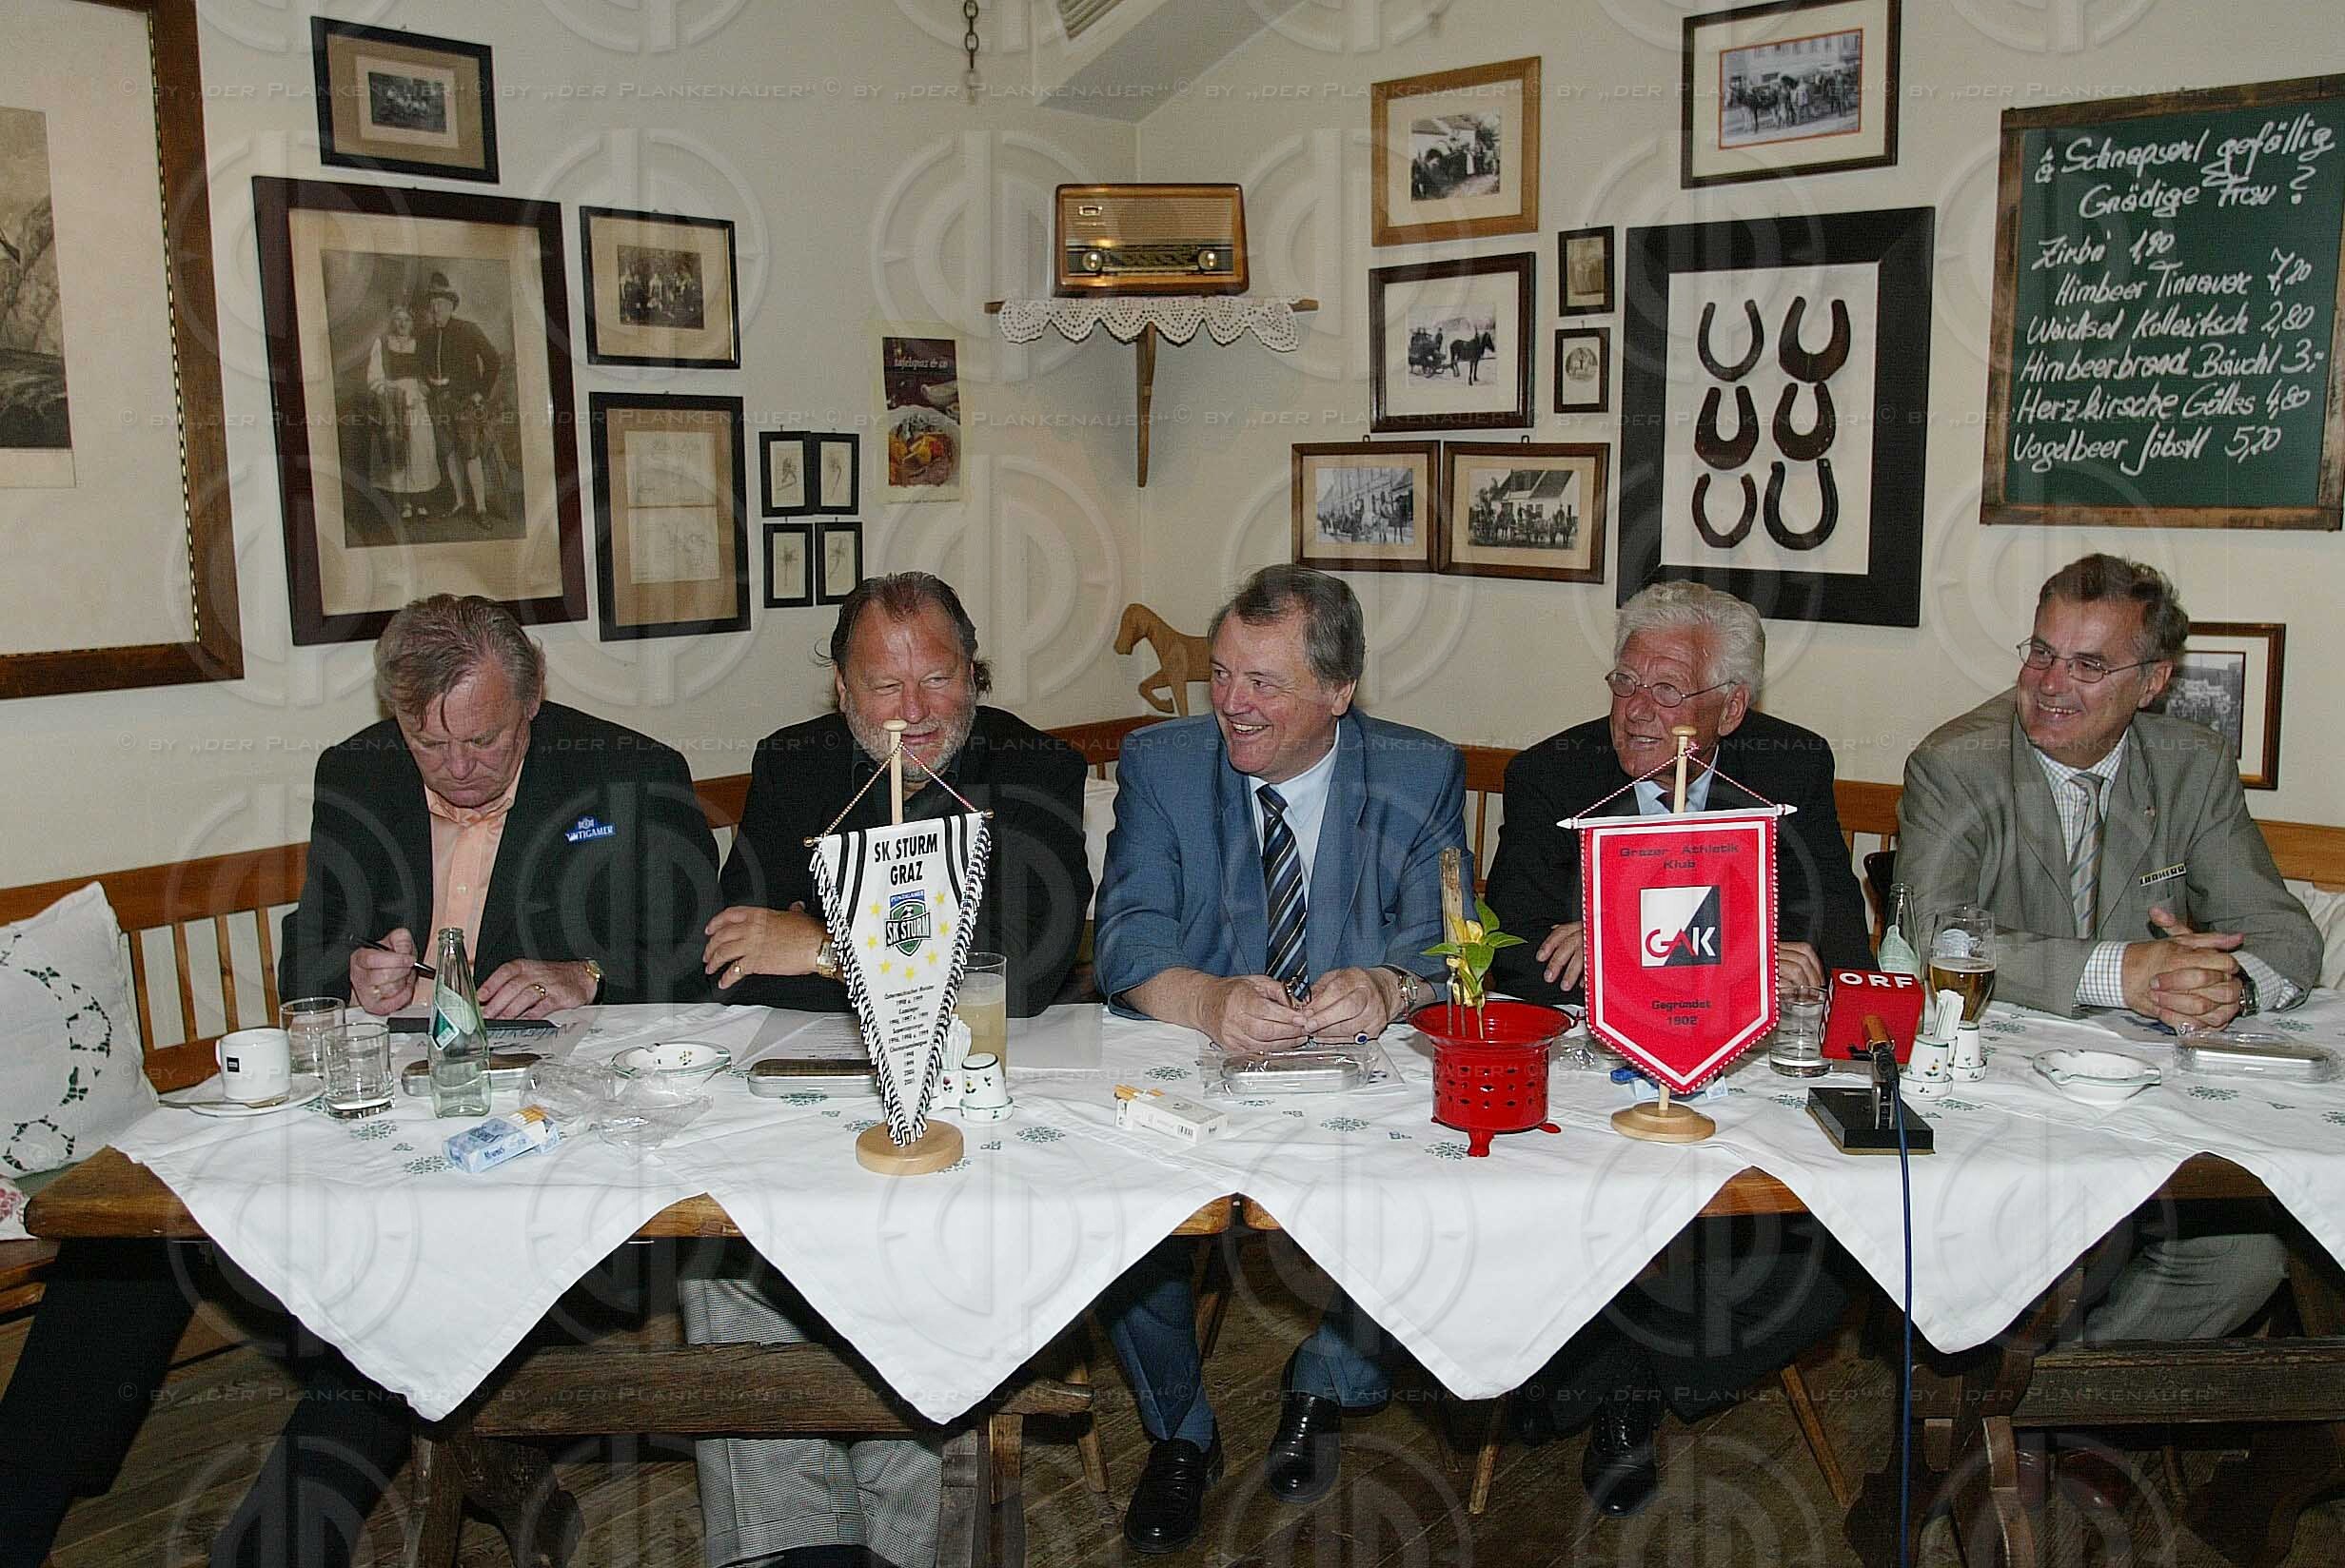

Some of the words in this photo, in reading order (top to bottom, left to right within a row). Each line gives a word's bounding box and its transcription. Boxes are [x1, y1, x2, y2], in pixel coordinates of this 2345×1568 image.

[2079, 178, 2199, 218] Gnädige
[2201, 175, 2276, 206] Frau
[2289, 165, 2317, 205] ?
[2055, 270, 2148, 306] Himbeer
[2261, 301, 2315, 339] 2,80
[2013, 428, 2128, 473] Vogelbeer
[874, 839, 891, 863] SK
[896, 833, 938, 858] STURM
[890, 861, 923, 886] GRAZ
[887, 922, 899, 945] SK
[900, 914, 930, 939] STURM
[1645, 926, 1716, 959] GAK
[1839, 972, 1913, 989] ORF
[1667, 1015, 1699, 1026] 1902
